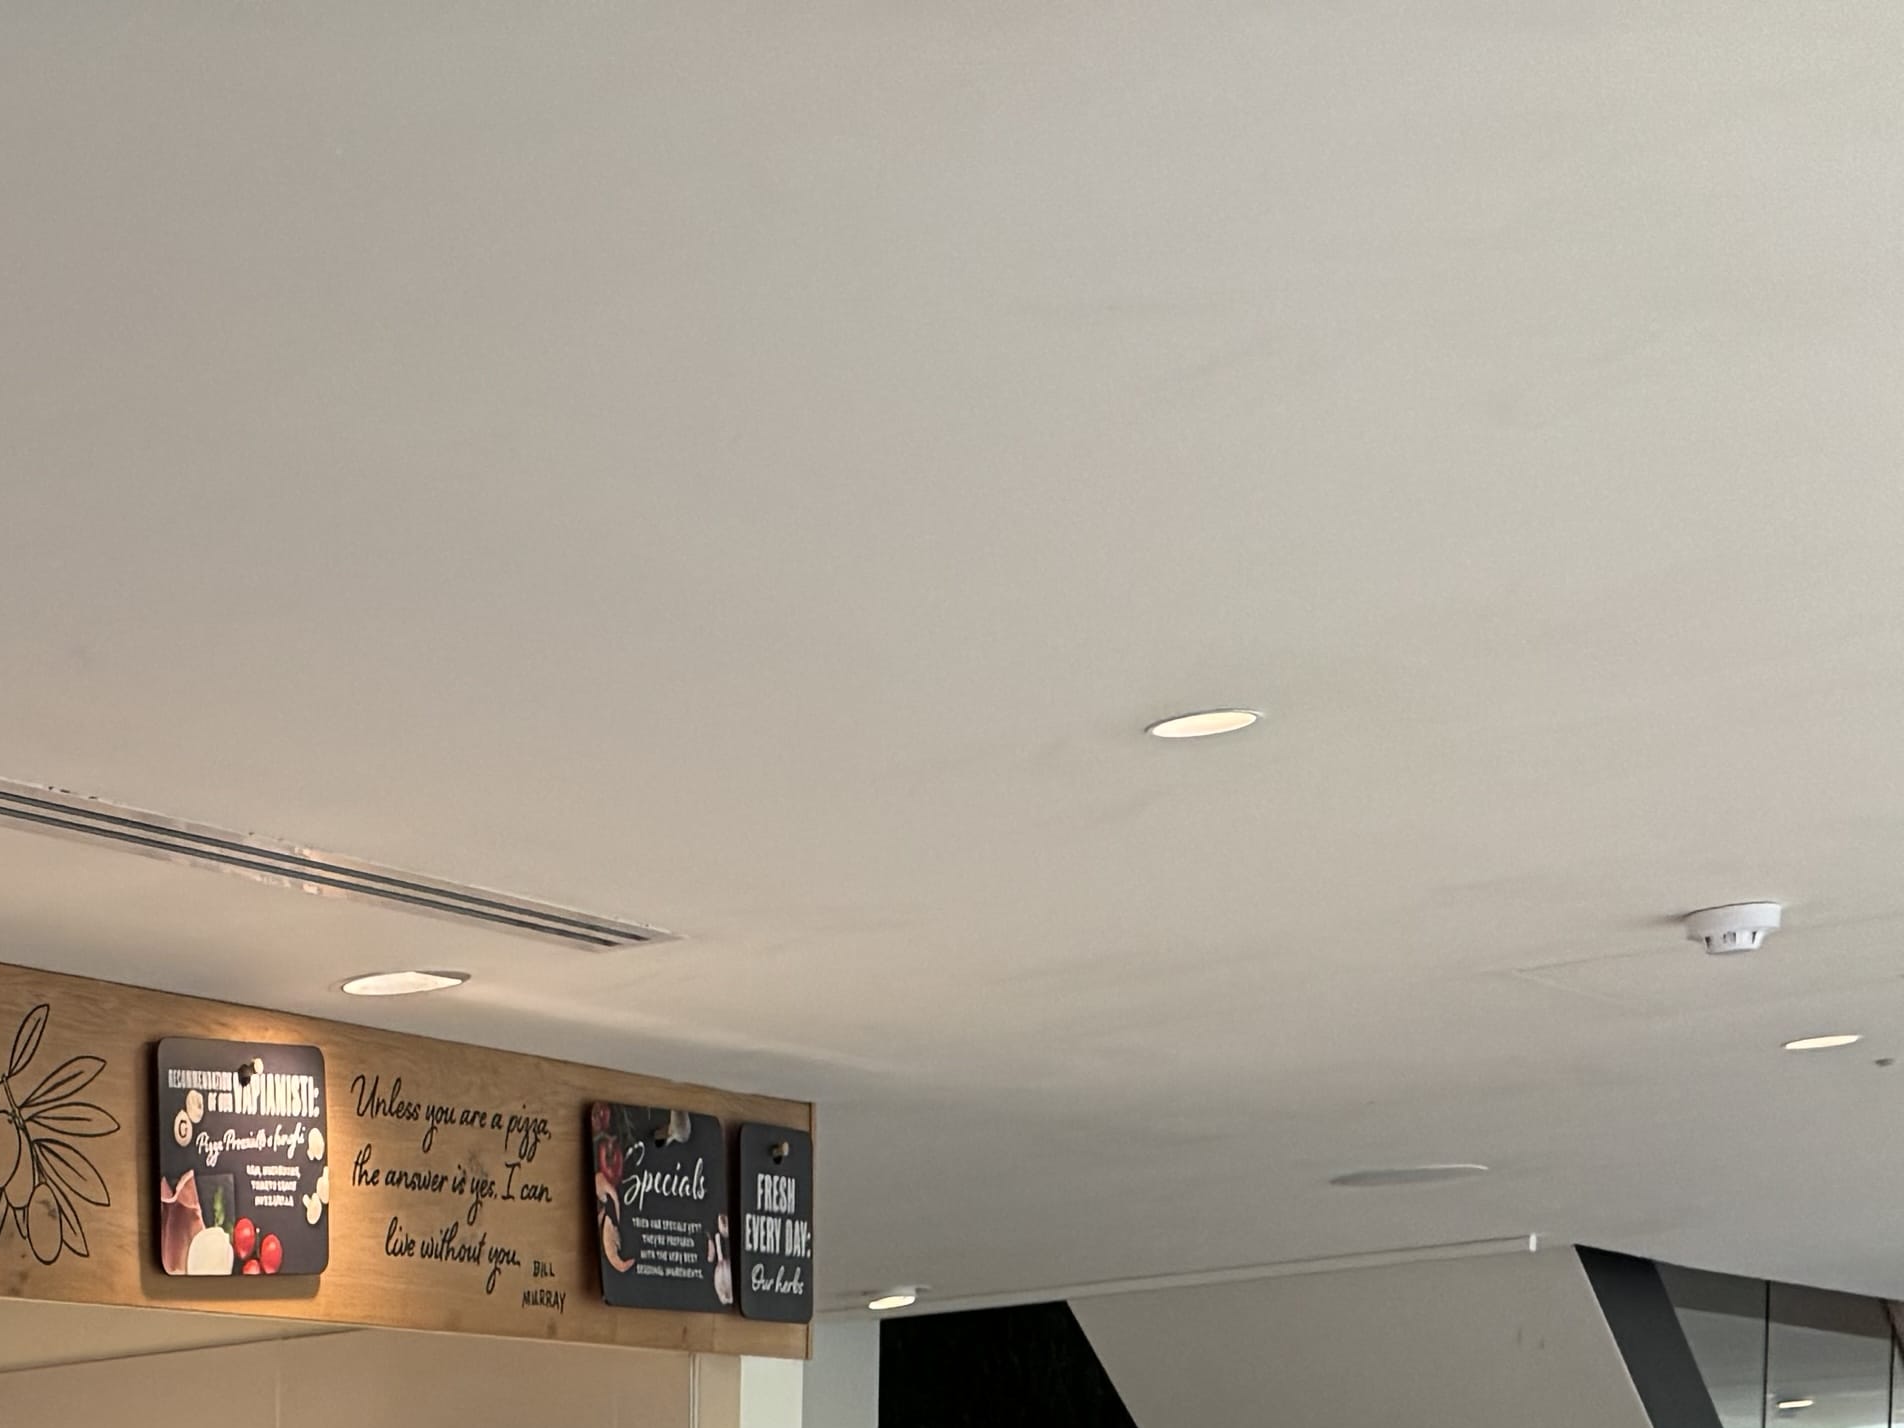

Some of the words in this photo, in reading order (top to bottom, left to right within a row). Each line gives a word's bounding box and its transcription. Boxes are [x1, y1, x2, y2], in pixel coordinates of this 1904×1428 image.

[350, 1074, 420, 1121] Unless
[422, 1103, 456, 1153] you
[459, 1107, 487, 1125] are
[491, 1112, 502, 1130] a
[505, 1103, 552, 1162] pizza,
[352, 1143, 379, 1187] the
[384, 1170, 448, 1192] answer
[451, 1164, 466, 1195] is
[467, 1176, 497, 1225] yes.
[501, 1162, 521, 1200] I
[520, 1183, 552, 1202] can
[622, 1141, 705, 1211] Specials
[756, 1173, 796, 1215] FRESH
[385, 1216, 416, 1256] live
[420, 1221, 488, 1265] without
[486, 1246, 521, 1295] you.
[745, 1213, 782, 1254] EVERY
[785, 1219, 811, 1259] DAY:
[533, 1260, 555, 1277] BILL
[751, 1263, 774, 1292] Our
[775, 1265, 804, 1295] herbs
[522, 1290, 567, 1314] MURRAY
